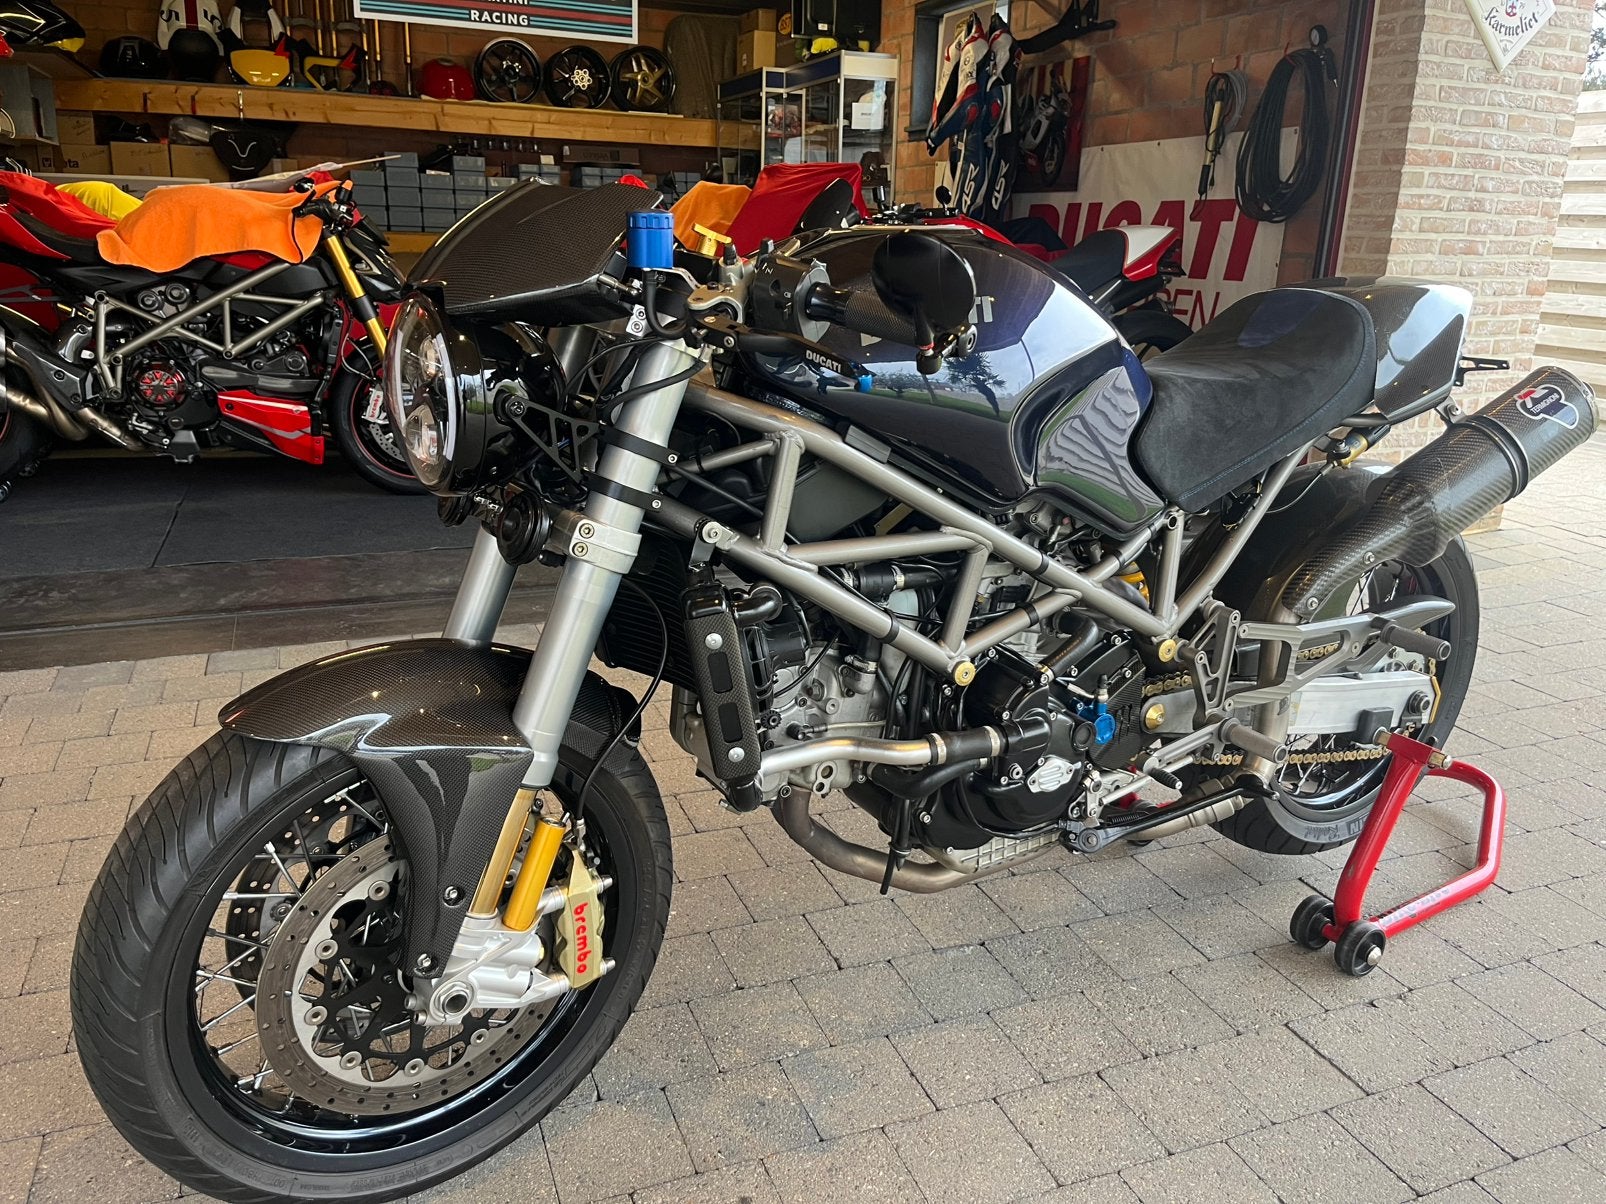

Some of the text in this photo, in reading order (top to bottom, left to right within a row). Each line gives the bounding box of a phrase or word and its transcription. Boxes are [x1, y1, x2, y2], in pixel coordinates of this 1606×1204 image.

[470, 9, 529, 26] RACING
[805, 349, 842, 373] DUCATI
[573, 902, 592, 974] brembo
